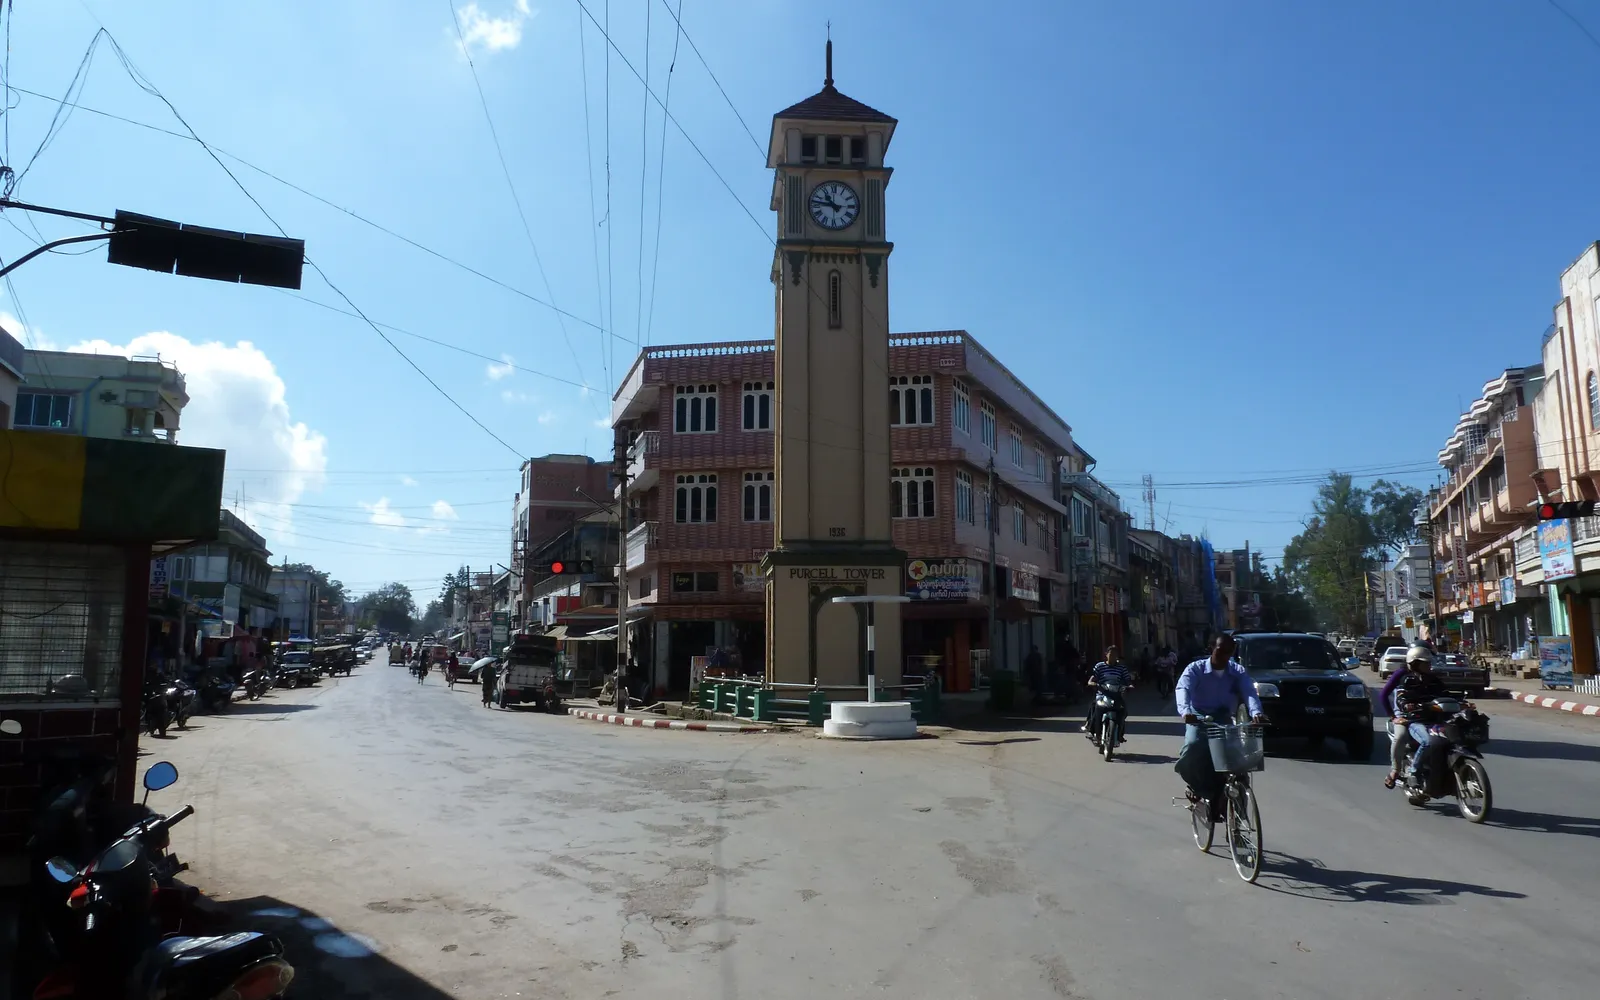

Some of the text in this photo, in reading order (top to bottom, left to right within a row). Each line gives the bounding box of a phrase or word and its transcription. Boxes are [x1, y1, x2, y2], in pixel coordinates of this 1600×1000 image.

[829, 527, 846, 537] 1936
[789, 568, 885, 579] PURCELL TOWER
